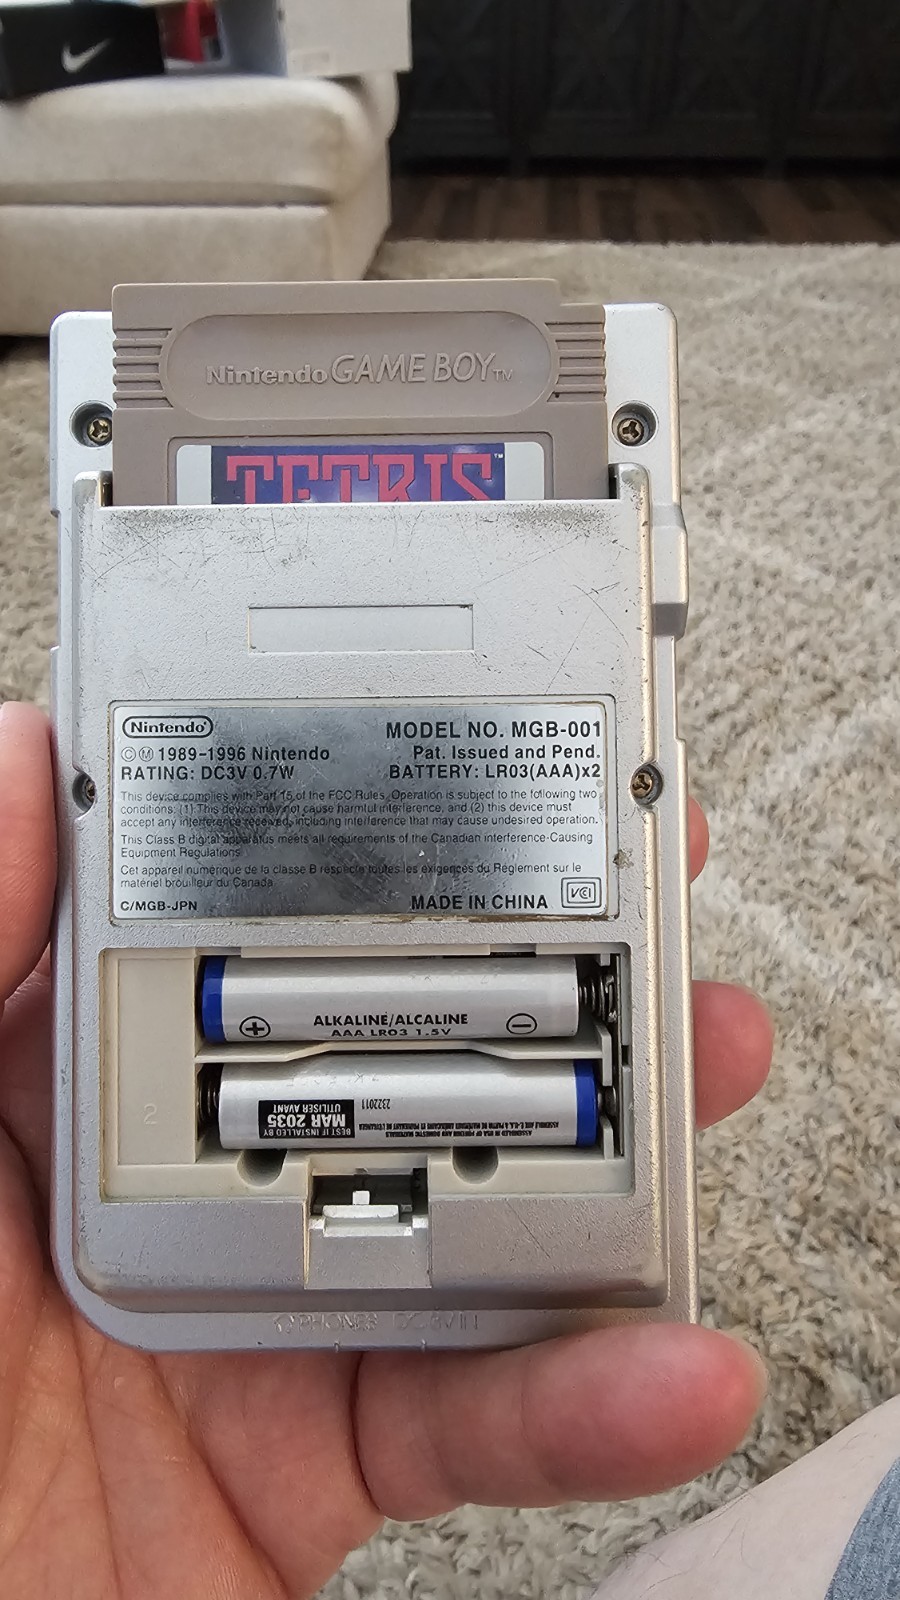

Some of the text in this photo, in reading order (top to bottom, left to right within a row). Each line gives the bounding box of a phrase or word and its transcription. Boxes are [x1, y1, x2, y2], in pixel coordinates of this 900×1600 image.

[206, 364, 328, 385] Nintendo
[331, 353, 426, 384] GAME
[433, 352, 495, 382] BOY
[226, 454, 492, 503] TETRIS
[131, 721, 207, 733] Nintendo
[386, 721, 601, 739] MODEL NO. MGB-001
[159, 747, 246, 761] 1989-1996
[252, 747, 330, 761] Nintendo
[413, 744, 601, 760] Pat. Issued and Pend.
[121, 765, 294, 780] RATING: DC3V 0.7W
[390, 764, 601, 781] BATTERY: LR03(AAA)x2
[121, 791, 142, 801] This
[146, 791, 179, 802] device
[182, 791, 229, 803] complies
[256, 791, 277, 800] Part
[282, 791, 293, 800] 15
[296, 790, 306, 800] of
[309, 790, 325, 800] the
[329, 790, 352, 800] FCC
[391, 789, 442, 801] Operation
[446, 790, 454, 799] is
[458, 790, 494, 801] subject
[498, 790, 507, 799] to
[511, 790, 526, 799] the
[531, 790, 576, 801] following
[579, 790, 597, 798] two
[121, 805, 176, 814] conditions:
[196, 804, 219, 813] This
[222, 803, 256, 813] device
[303, 805, 334, 813] cause
[337, 803, 377, 813] harmful
[448, 803, 467, 812] and
[471, 803, 484, 814] (2)
[488, 802, 506, 812] this
[510, 802, 543, 812] device
[547, 803, 572, 811] must
[121, 818, 155, 829] accept
[158, 819, 176, 829] any
[345, 816, 406, 825] interference
[410, 816, 429, 825] that
[432, 817, 453, 826] may
[458, 817, 488, 825] cause
[492, 815, 543, 824] undesired
[546, 815, 598, 826] operation.
[121, 834, 143, 844] This
[146, 834, 175, 844] Class
[178, 834, 185, 843] B
[189, 834, 220, 846] digital
[223, 835, 274, 845] apparatus
[278, 835, 308, 843] meets
[313, 834, 324, 843] all
[328, 834, 396, 845] requirements
[399, 833, 408, 843] of
[412, 833, 427, 843] the
[431, 832, 480, 843] Canadian
[121, 847, 176, 858] Equipment
[121, 865, 139, 875] Cet
[142, 865, 184, 877] appareil
[244, 865, 257, 874] de
[261, 865, 270, 874] la
[273, 864, 306, 874] classe
[309, 864, 316, 873] B
[404, 864, 418, 873] les
[421, 864, 474, 876] exigences
[477, 863, 491, 873] du
[573, 863, 581, 872] le
[165, 877, 213, 888] brouilleur
[216, 878, 229, 887] du
[233, 877, 274, 887] Canada
[121, 901, 197, 911] C/MGB-JPN
[412, 895, 548, 910] MADE IN CHINA
[313, 1013, 469, 1027] ALKALINE/ALCALINE
[331, 1029, 364, 1037] AAA
[370, 1029, 408, 1037] LR03
[144, 1103, 158, 1125] 2
[273, 1104, 341, 1113] UTILISER AVANT
[267, 1114, 345, 1128] MAR 2035
[276, 1128, 319, 1136] INSTALLED
[321, 1128, 329, 1136] IF
[331, 1128, 351, 1136] BEST
